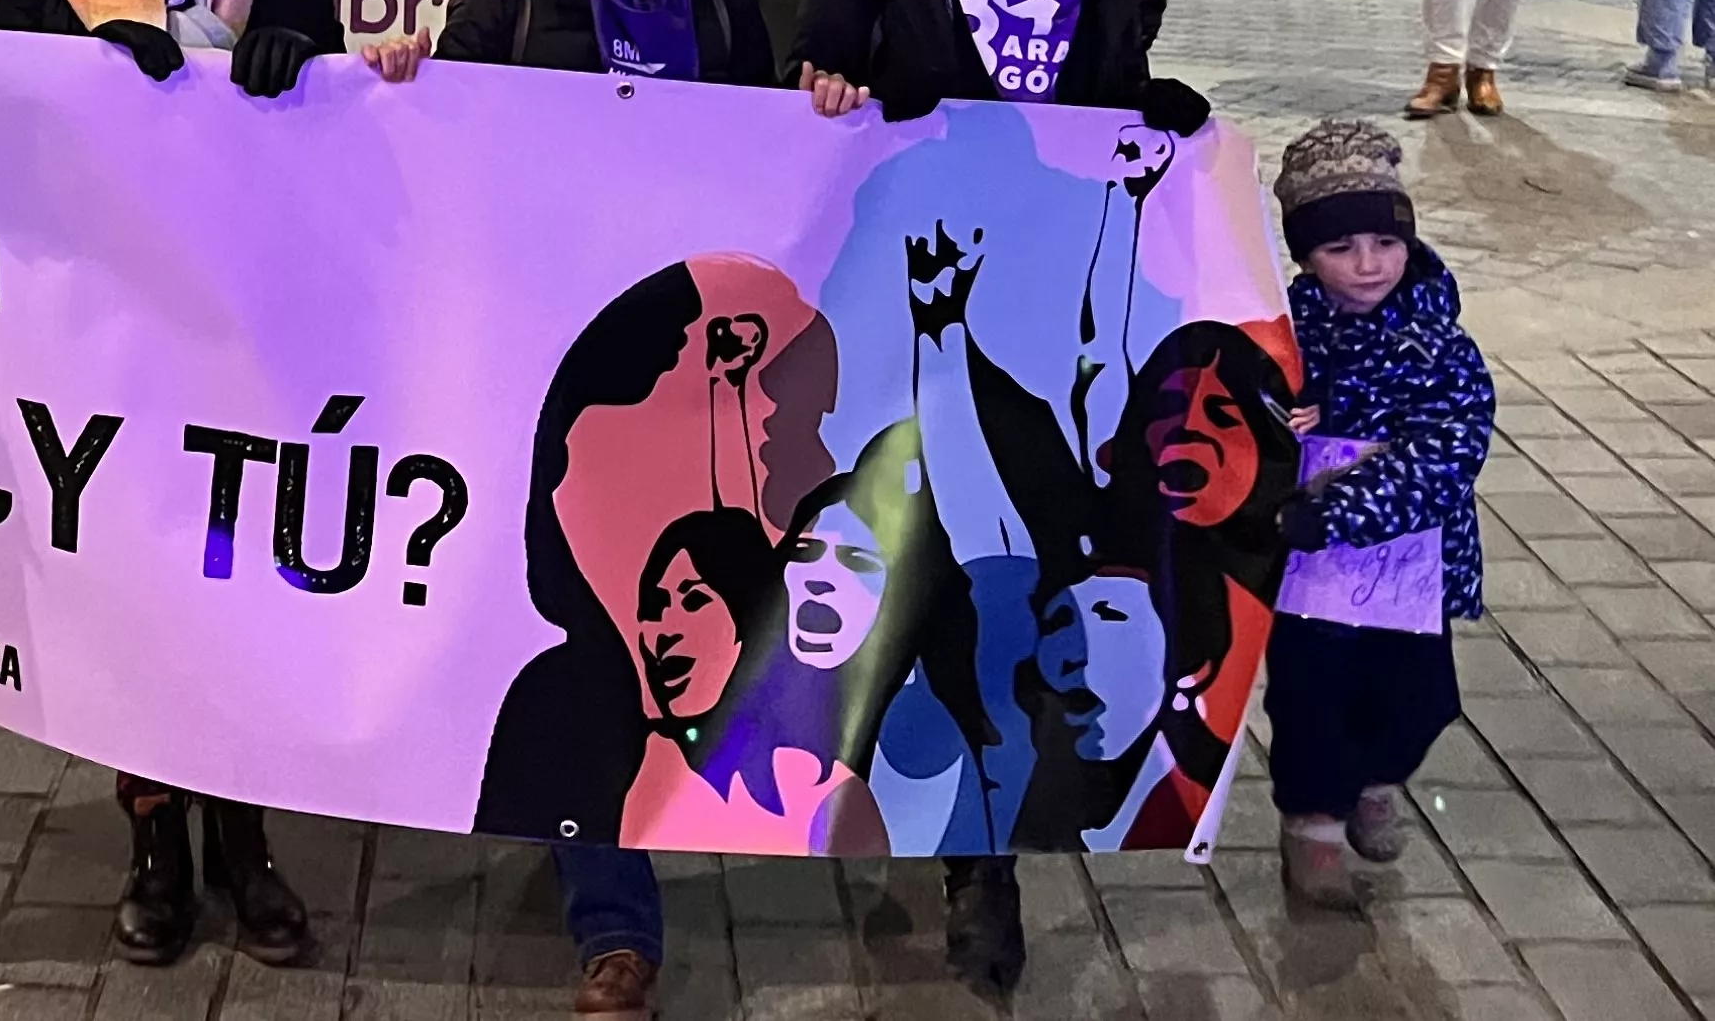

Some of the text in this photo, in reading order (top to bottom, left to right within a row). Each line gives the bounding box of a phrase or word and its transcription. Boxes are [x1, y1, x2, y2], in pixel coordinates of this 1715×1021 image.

[613, 38, 640, 62] 8M
[998, 64, 1058, 94] GÓ
[183, 394, 469, 607] TÚ?
